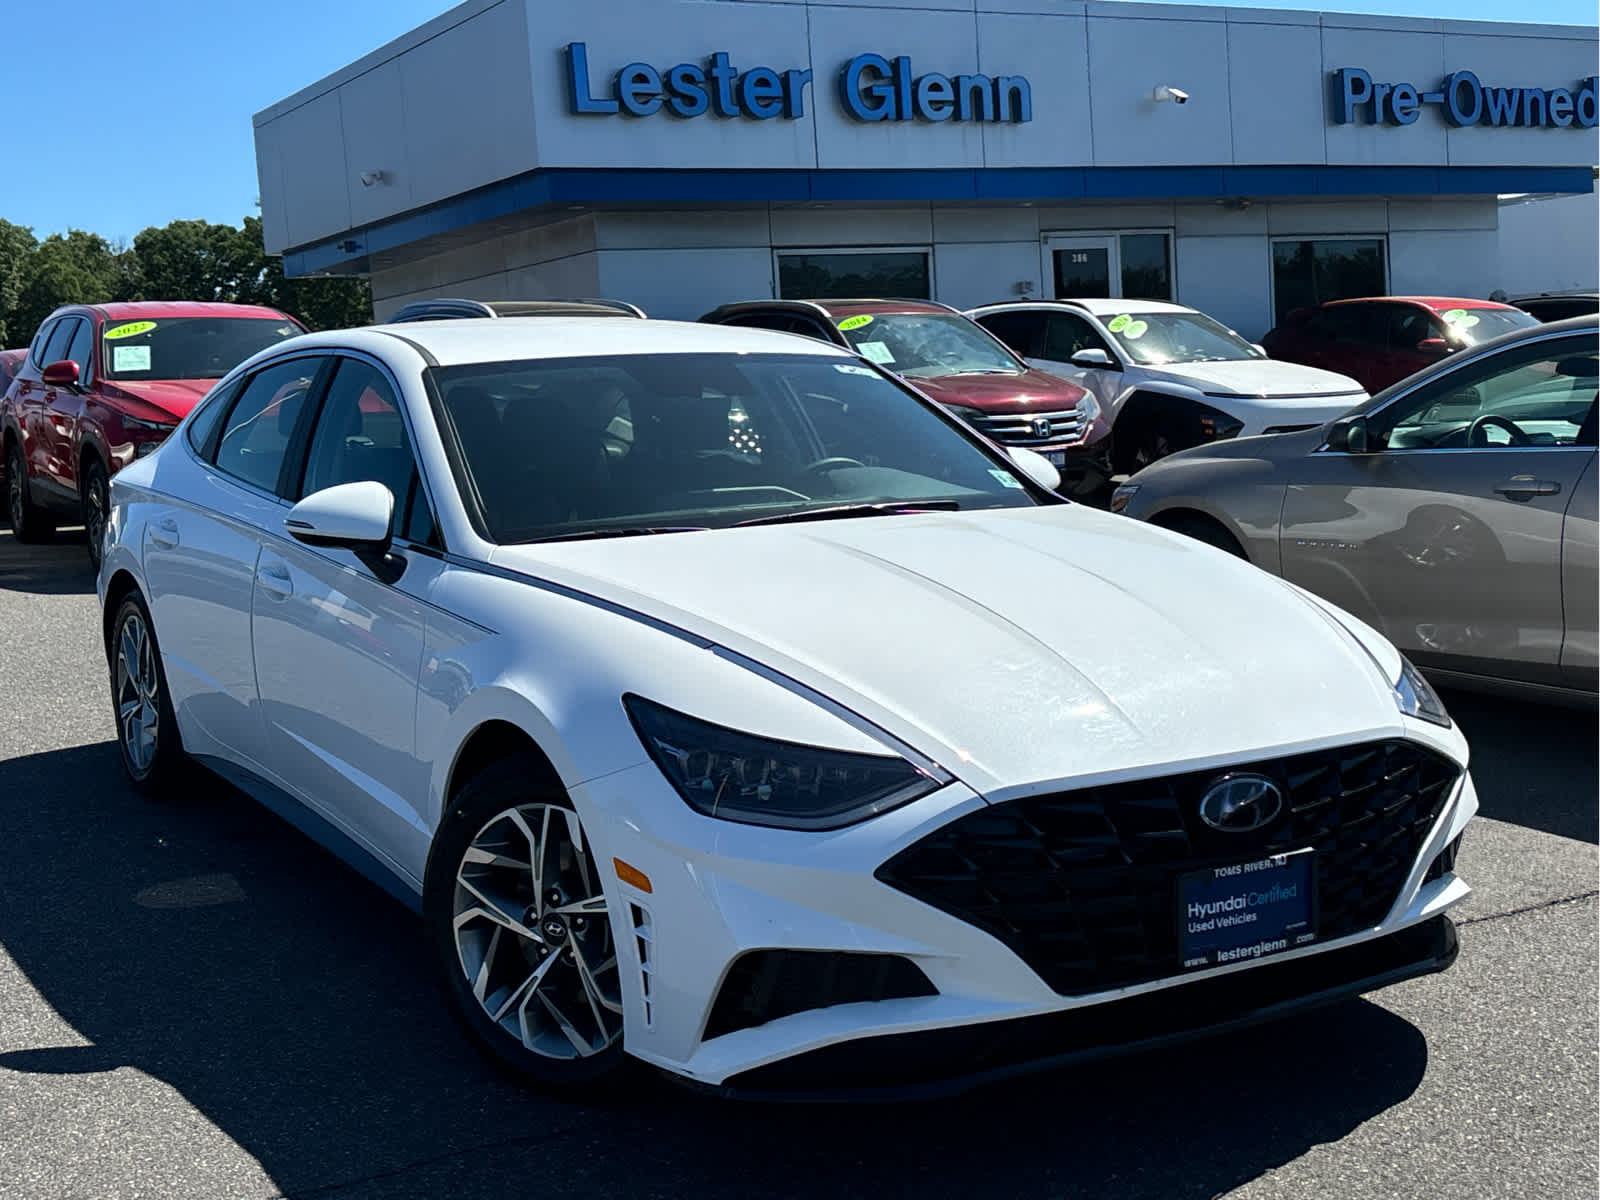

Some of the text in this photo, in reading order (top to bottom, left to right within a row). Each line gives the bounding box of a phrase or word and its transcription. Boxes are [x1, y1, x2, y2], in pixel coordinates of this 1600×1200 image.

[565, 42, 1033, 122] Lester Glenn
[1332, 67, 1599, 128] Pre-Owned
[116, 323, 146, 337] 2022
[845, 316, 867, 328] 2014
[1214, 864, 1242, 878] TOMS
[1187, 883, 1297, 918] Hyundai Certified
[1187, 912, 1258, 934] Used Vehicles
[1217, 939, 1287, 962] lesterglenn
